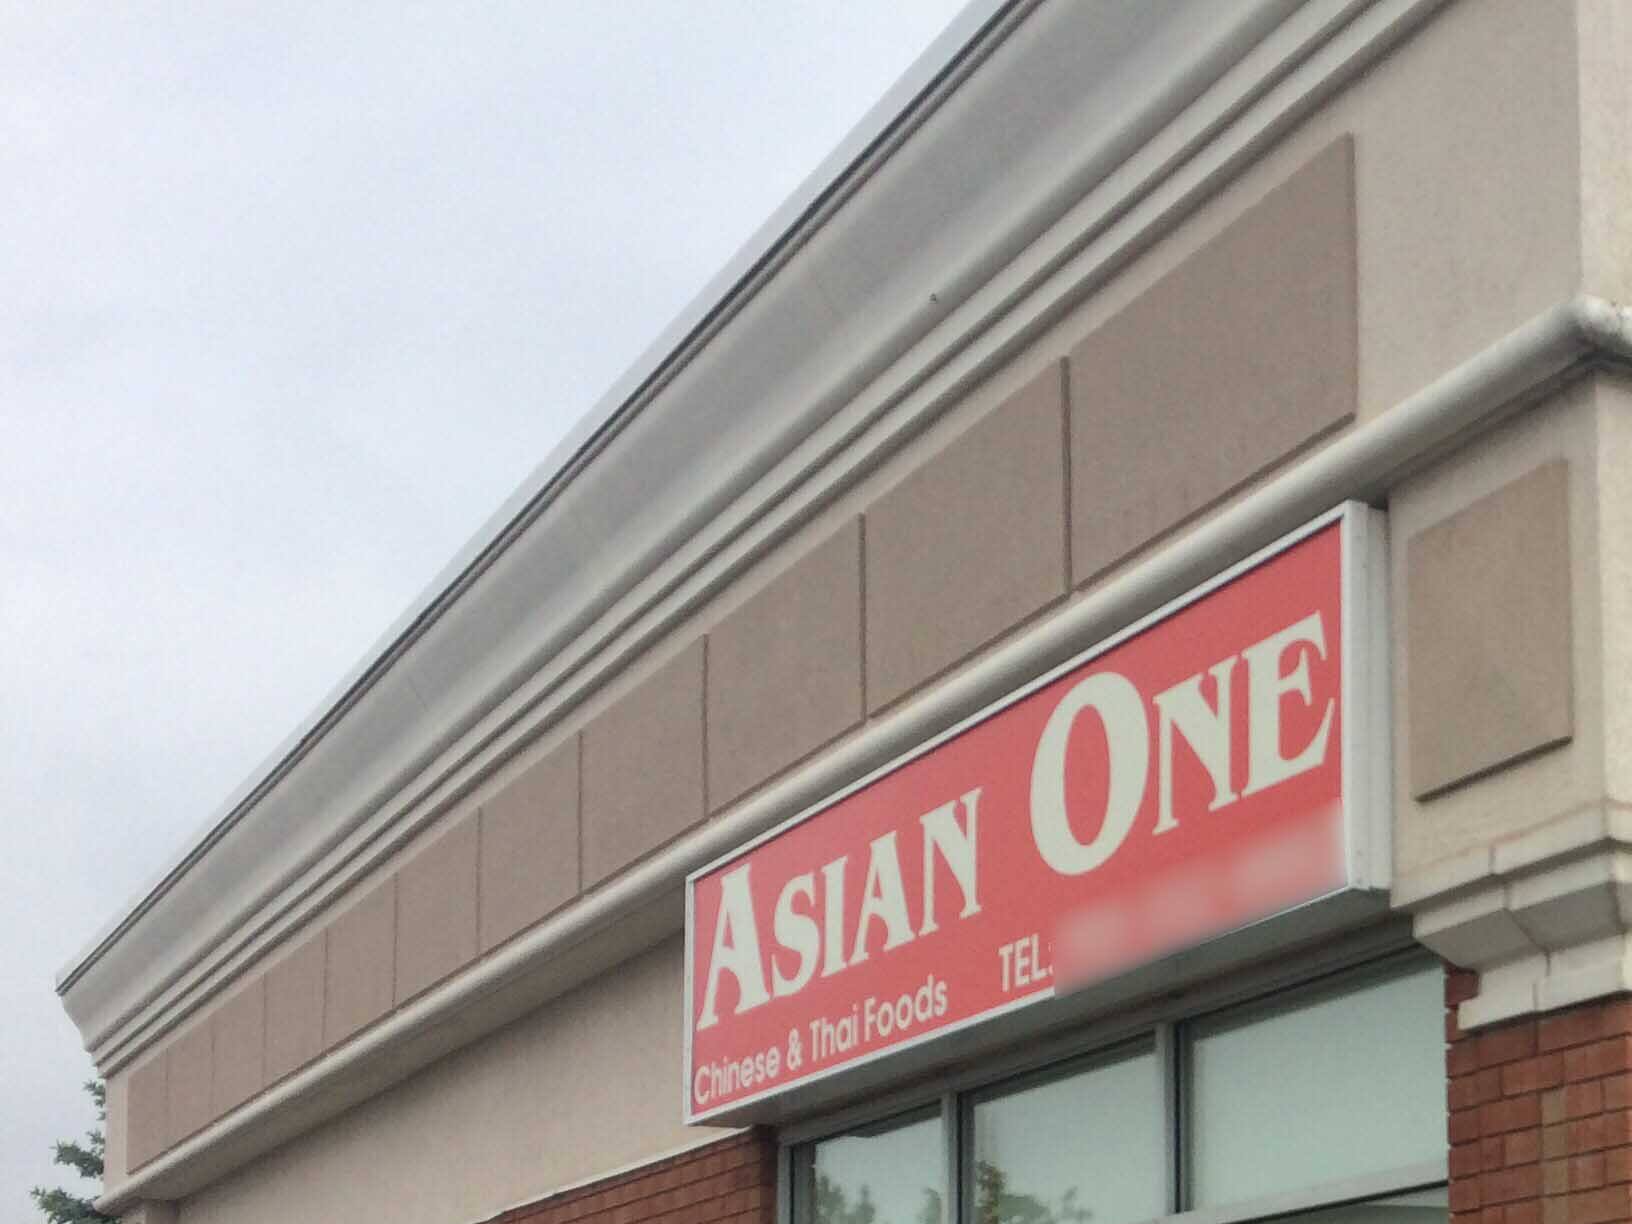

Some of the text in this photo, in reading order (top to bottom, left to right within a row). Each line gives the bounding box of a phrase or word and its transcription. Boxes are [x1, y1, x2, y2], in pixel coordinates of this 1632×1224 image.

[696, 787, 983, 1031] ASIAN
[1029, 610, 1337, 876] ONE
[693, 973, 949, 1105] Chinese & Thai Foods
